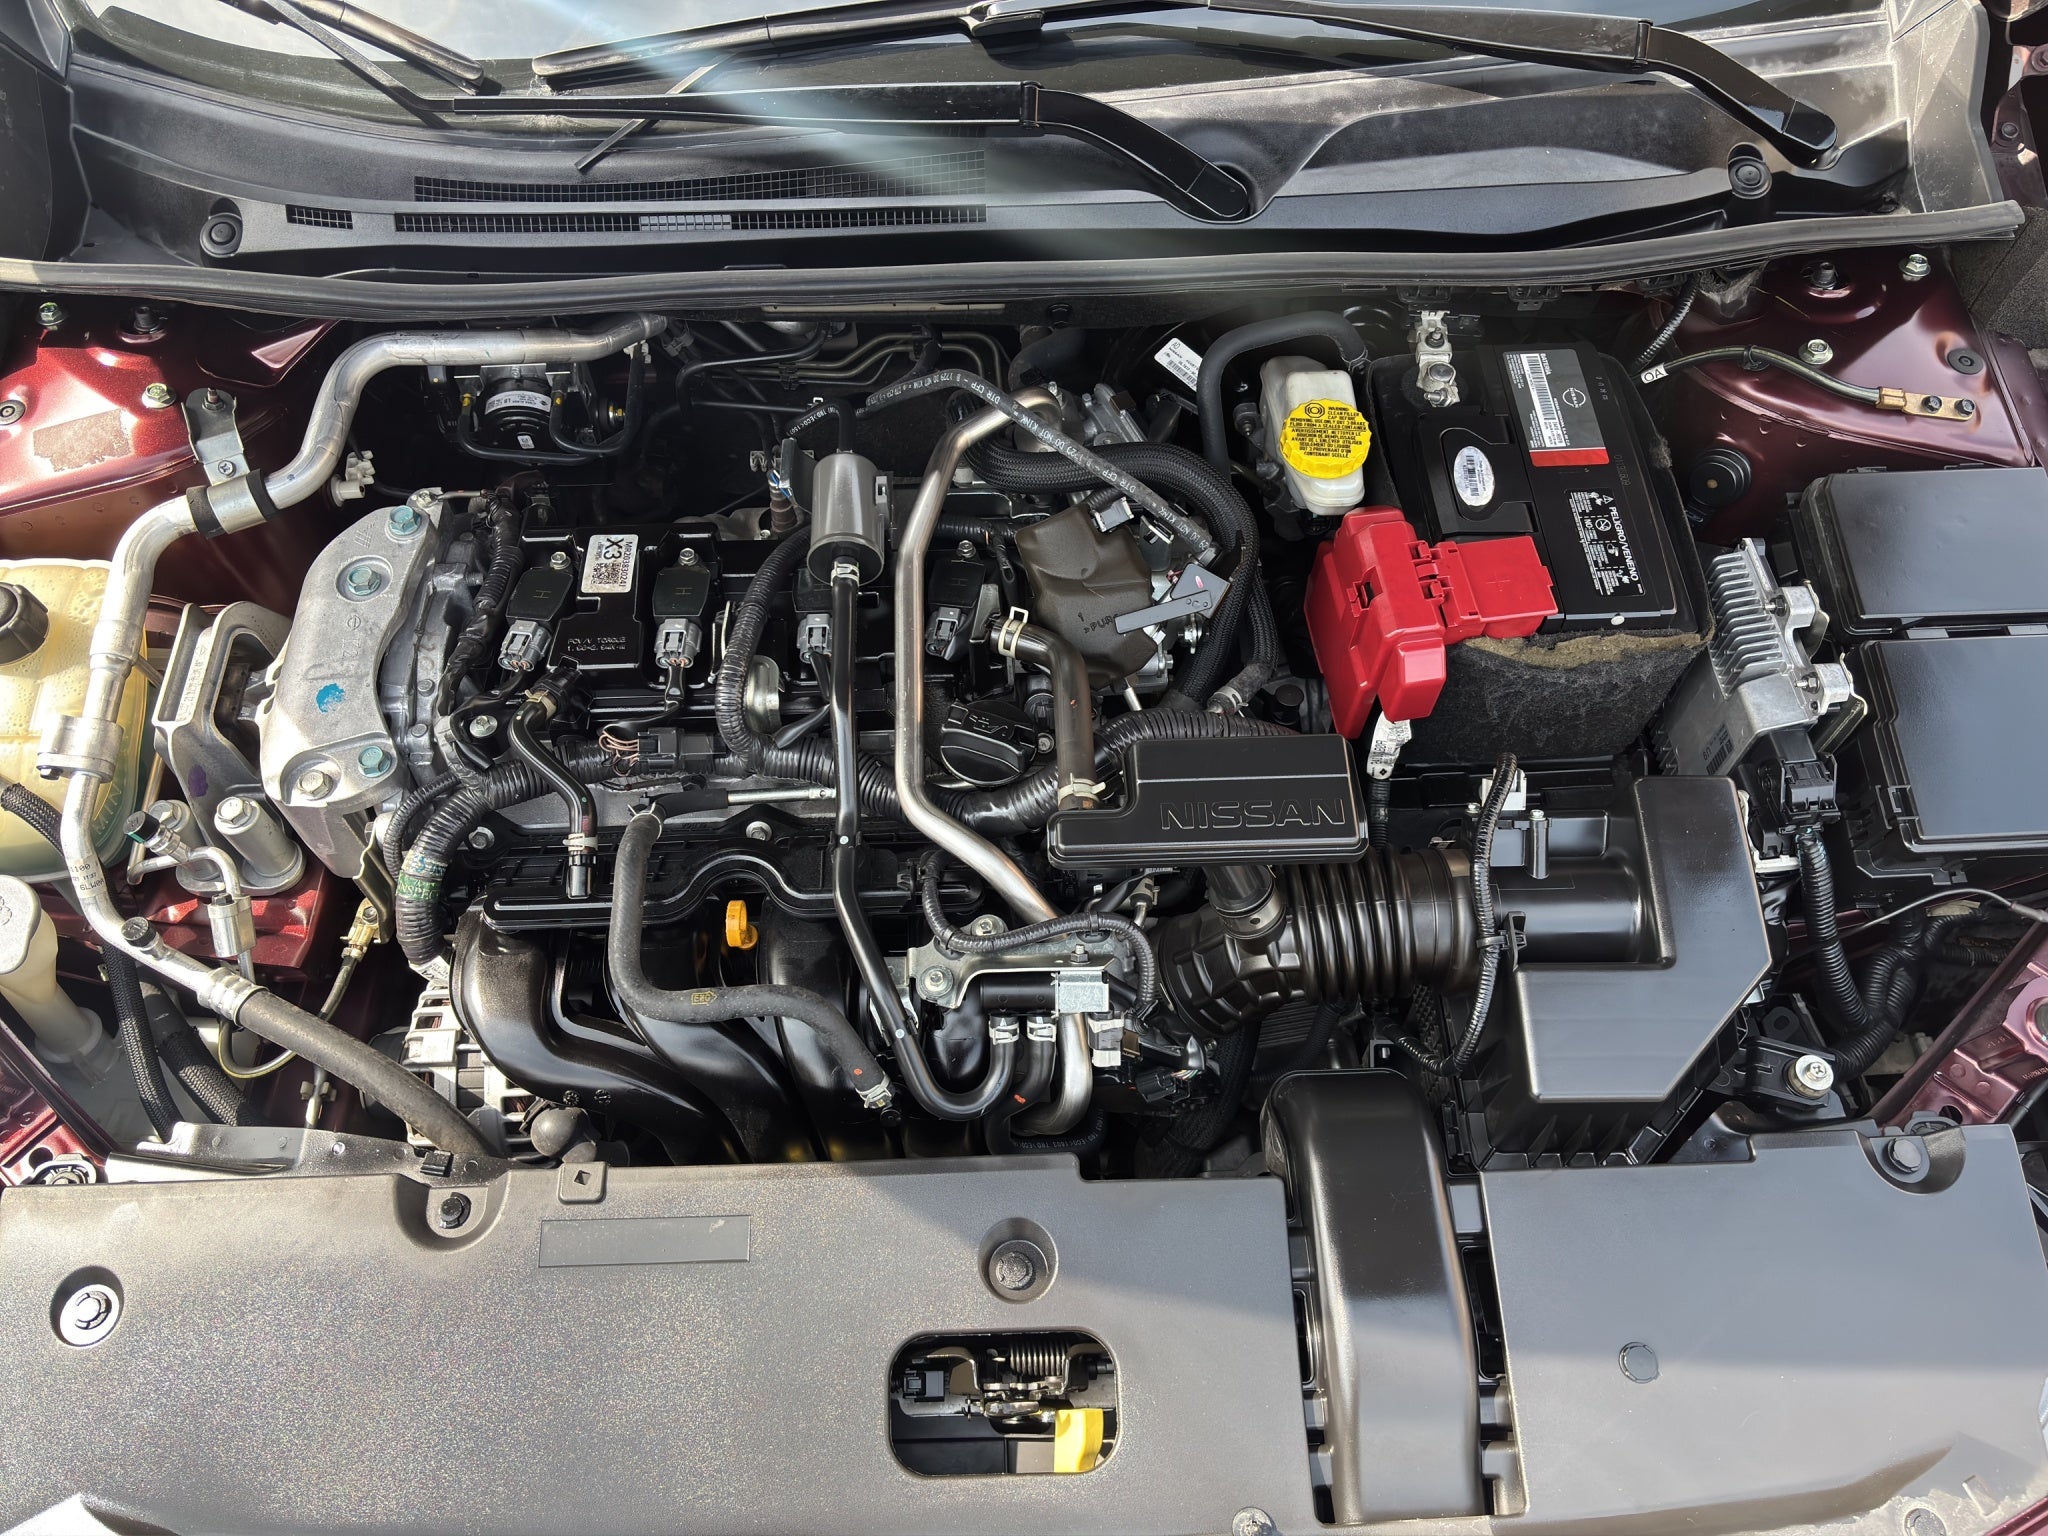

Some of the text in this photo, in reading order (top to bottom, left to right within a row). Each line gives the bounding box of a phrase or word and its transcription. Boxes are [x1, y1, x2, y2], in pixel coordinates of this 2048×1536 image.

[1540, 354, 1552, 374] BATERÍA
[1570, 388, 1579, 408] NISSAN
[1020, 416, 1039, 431] KINK
[1039, 428, 1054, 444] NOT
[1102, 469, 1118, 481] CFP
[1120, 479, 1136, 493] DTR
[604, 538, 624, 559] X3
[1609, 507, 1639, 580] PELIGRO/VENENO
[1159, 798, 1346, 830] NISSAN
